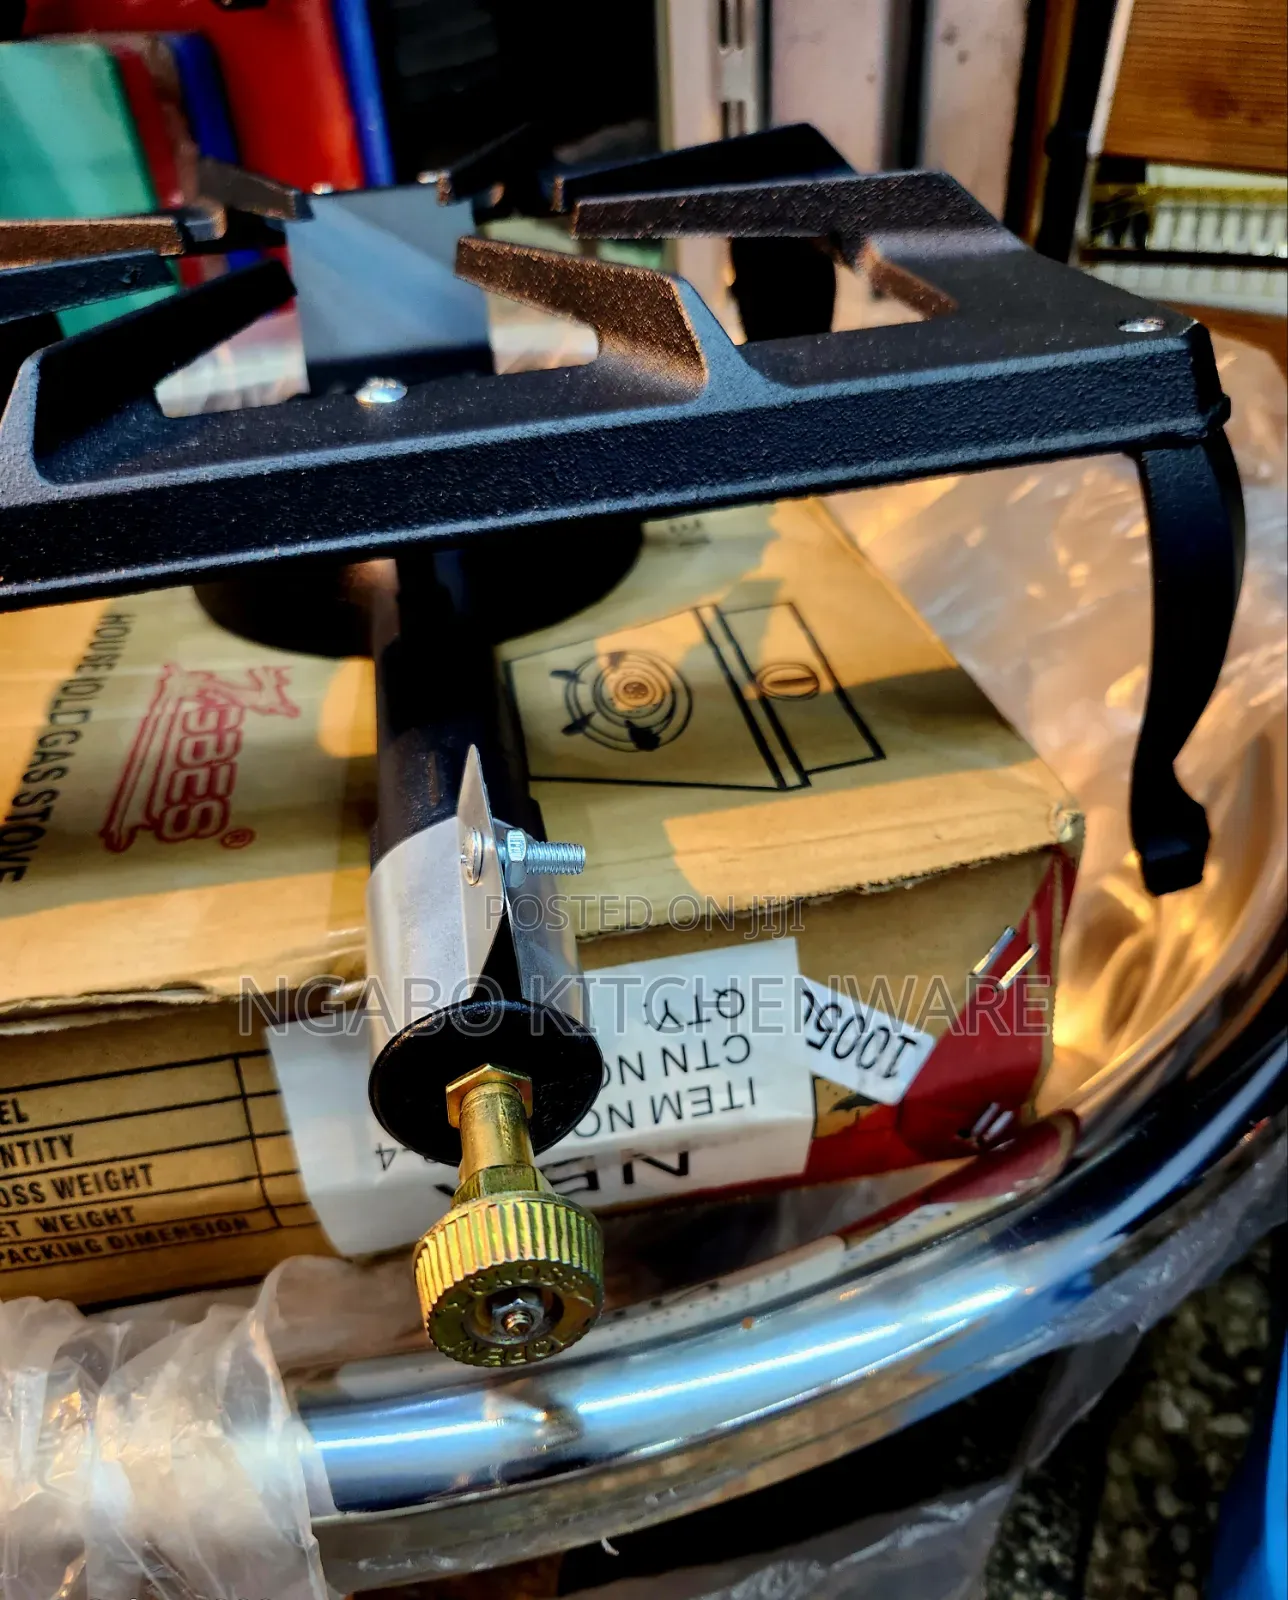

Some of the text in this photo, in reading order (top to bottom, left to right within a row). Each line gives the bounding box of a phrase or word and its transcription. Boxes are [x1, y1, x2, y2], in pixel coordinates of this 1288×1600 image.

[21, 729, 82, 784] GAS
[660, 1034, 751, 1078] CTN
[651, 1076, 757, 1125] ITEM
[51, 1163, 153, 1200] WEIGHT
[35, 1205, 136, 1234] WEIGHT
[107, 1217, 249, 1250] DIMENSION
